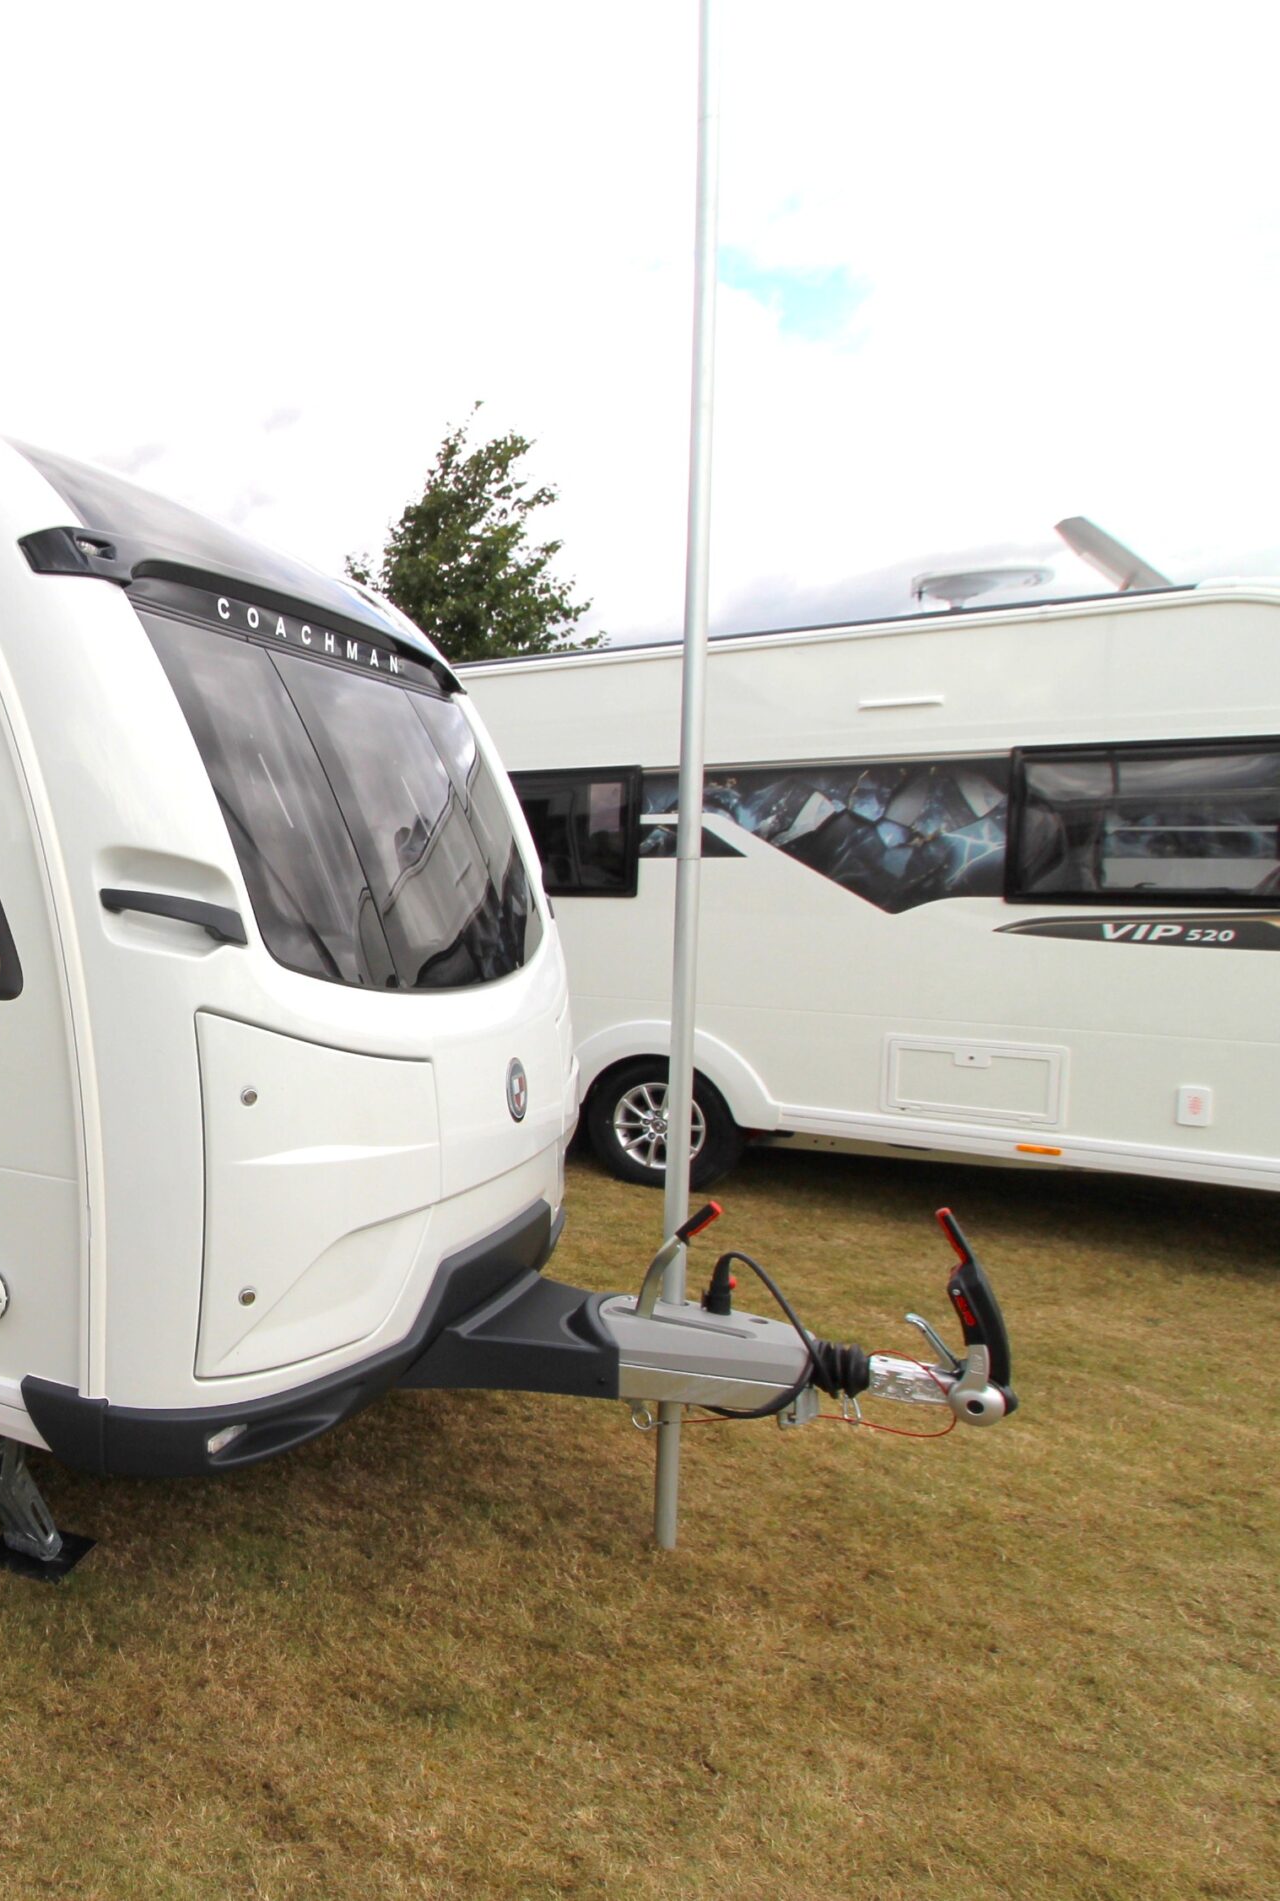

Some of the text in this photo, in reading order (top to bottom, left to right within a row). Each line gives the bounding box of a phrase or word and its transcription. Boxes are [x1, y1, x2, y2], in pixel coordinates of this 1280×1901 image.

[217, 598, 400, 674] COACHMAN
[1102, 923, 1236, 942] VIP 520
